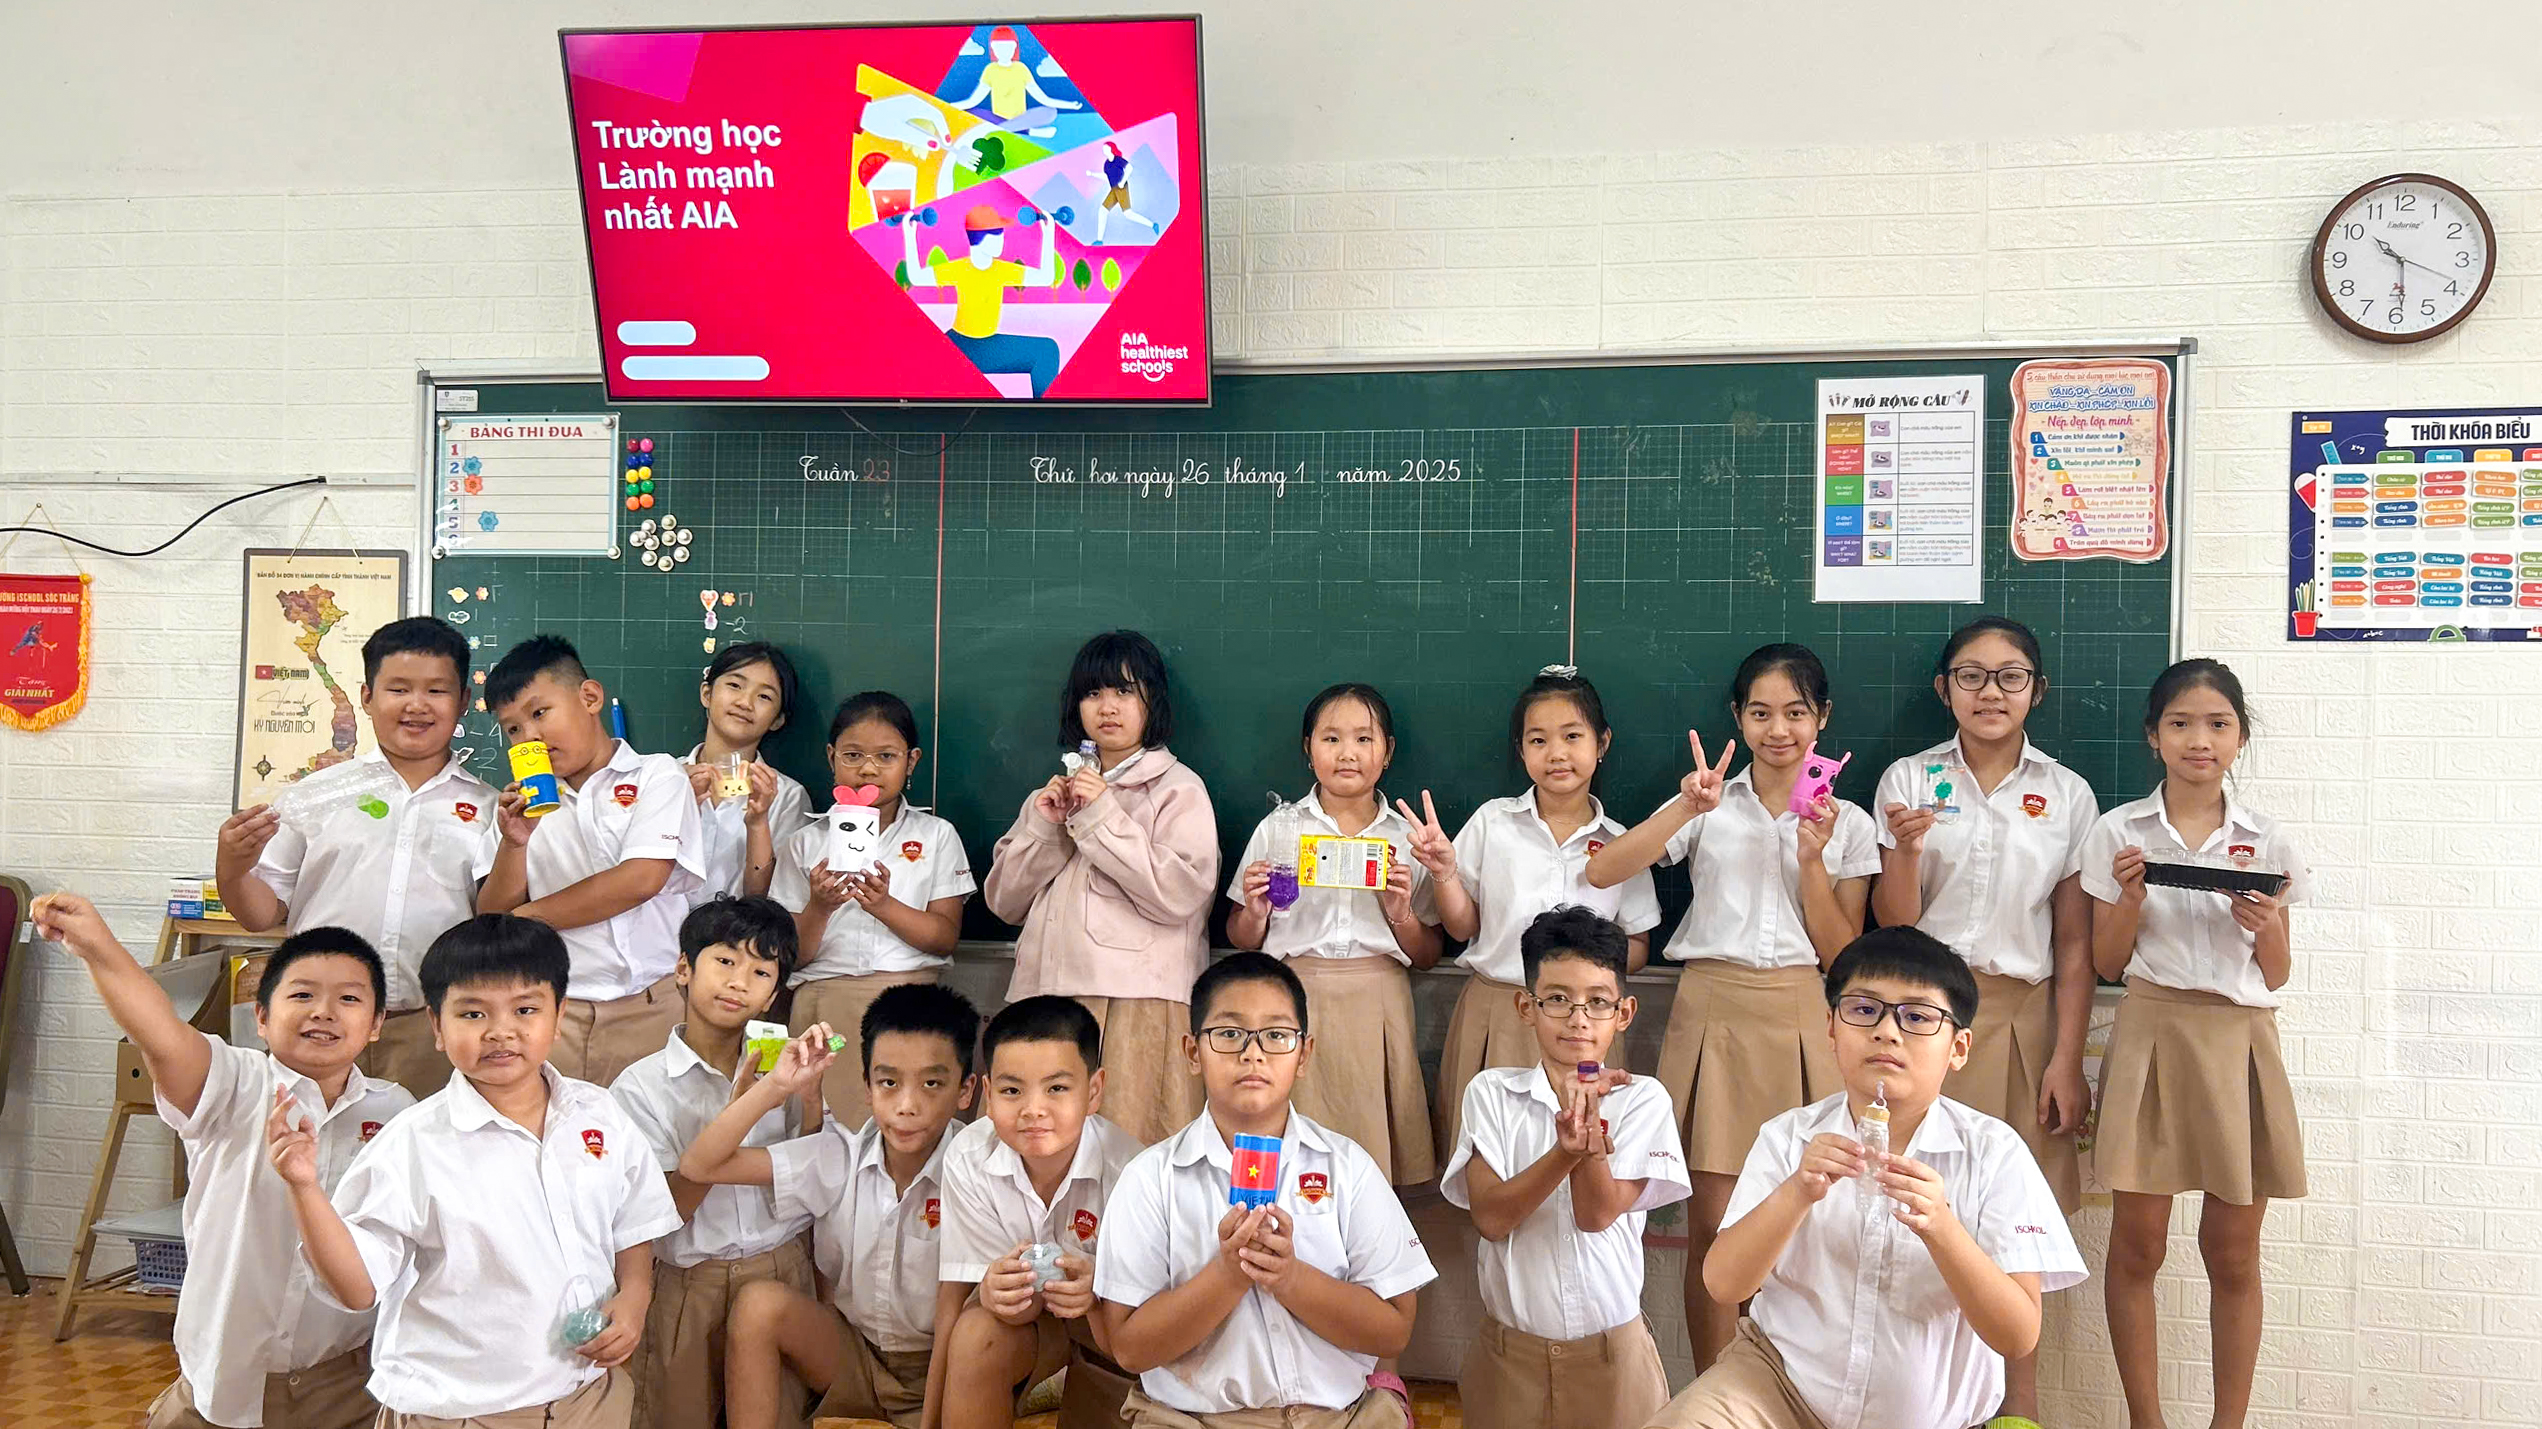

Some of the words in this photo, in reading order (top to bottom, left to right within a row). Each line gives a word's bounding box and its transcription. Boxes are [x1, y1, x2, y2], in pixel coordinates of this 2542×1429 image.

[592, 119, 713, 155] Trường
[721, 118, 782, 154] học
[598, 161, 677, 189] Lành
[686, 159, 774, 195] mạnh
[2367, 203, 2383, 220] 11
[2394, 195, 2416, 211] 12
[2431, 203, 2438, 219] 1
[604, 195, 674, 229] nhất
[681, 201, 738, 229] AIA
[2344, 223, 2364, 240] 10
[2387, 221, 2421, 229] Enduring
[2447, 222, 2463, 239] 2
[2332, 252, 2347, 269] 9
[2455, 251, 2470, 268] 3
[2339, 279, 2355, 296] 8
[2443, 280, 2458, 296] 4
[2360, 299, 2374, 316] 7
[2388, 307, 2404, 324] 6
[2420, 299, 2435, 316] 5
[1121, 332, 1149, 345] AIA
[1121, 345, 1189, 359] healthiest
[1121, 359, 1173, 373] schools
[1853, 393, 1876, 408] MỞ
[1879, 394, 1920, 409] RỘNG
[1923, 393, 1951, 407] CÂU
[470, 423, 514, 438] BẢNG
[518, 427, 544, 438] THI
[548, 425, 583, 438] ĐUA
[2411, 421, 2446, 441] THỜI
[2450, 420, 2492, 440] KHÓA
[2496, 416, 2531, 439] BIỂU
[451, 443, 459, 456] 1
[450, 462, 459, 474] 2
[798, 456, 858, 482] Tuần
[863, 457, 890, 482] 23
[1030, 456, 1075, 484] Thứ
[1124, 466, 1175, 498] ngày
[1181, 458, 1210, 484] 26
[1224, 457, 1287, 498] tháng
[1294, 461, 1305, 484] 1
[1336, 466, 1391, 483] năm
[1399, 458, 1461, 482] 2025
[449, 480, 459, 492] 3
[449, 516, 459, 529] 5
